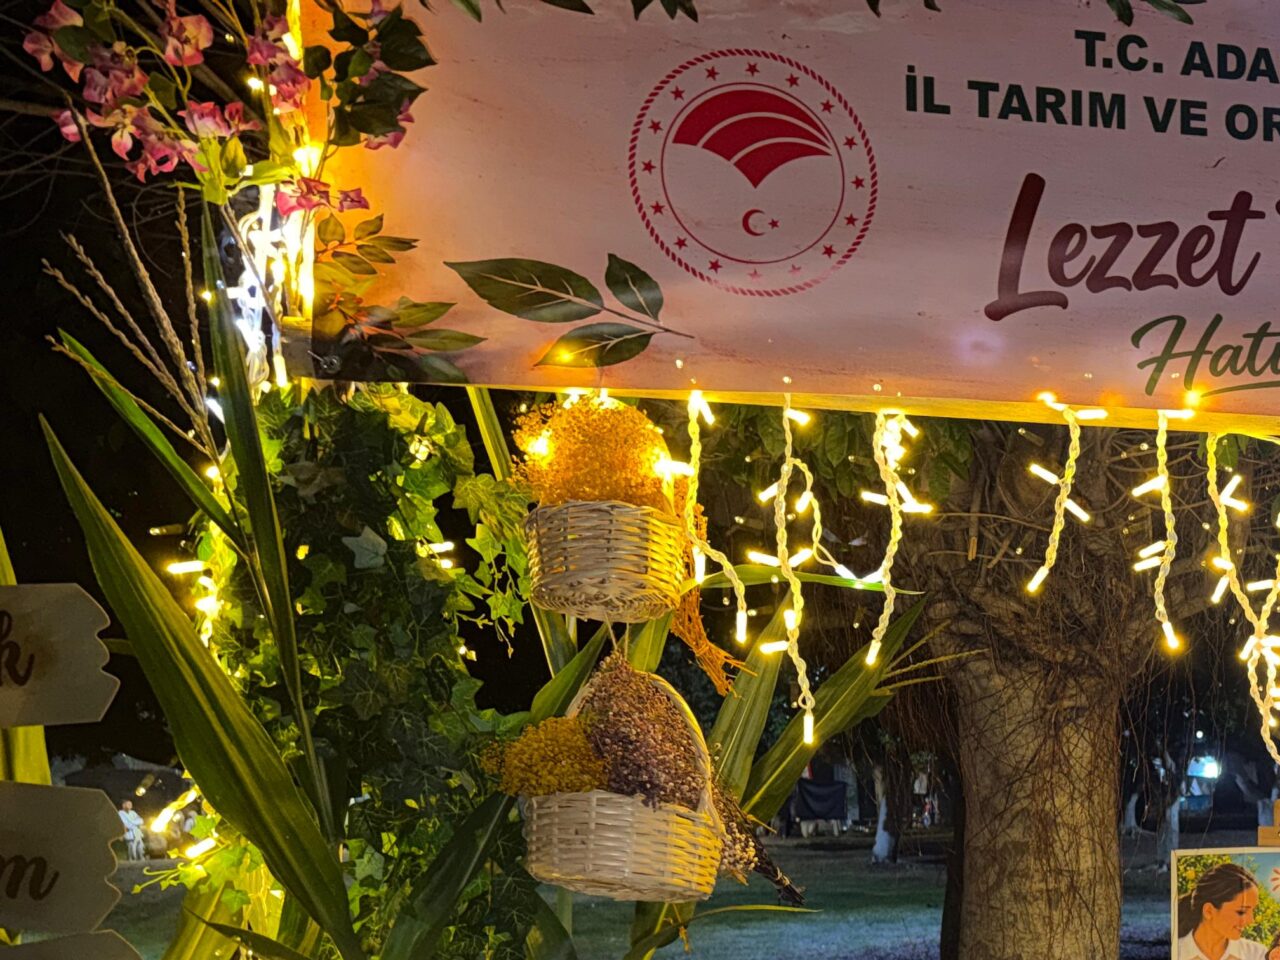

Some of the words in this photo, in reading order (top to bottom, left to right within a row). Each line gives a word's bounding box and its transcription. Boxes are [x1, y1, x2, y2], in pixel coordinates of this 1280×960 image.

[1075, 30, 1163, 74] T.C.
[904, 64, 951, 115] İL
[967, 79, 1127, 131] TARIM
[1143, 97, 1208, 137] VE
[984, 172, 1266, 321] Lezzet
